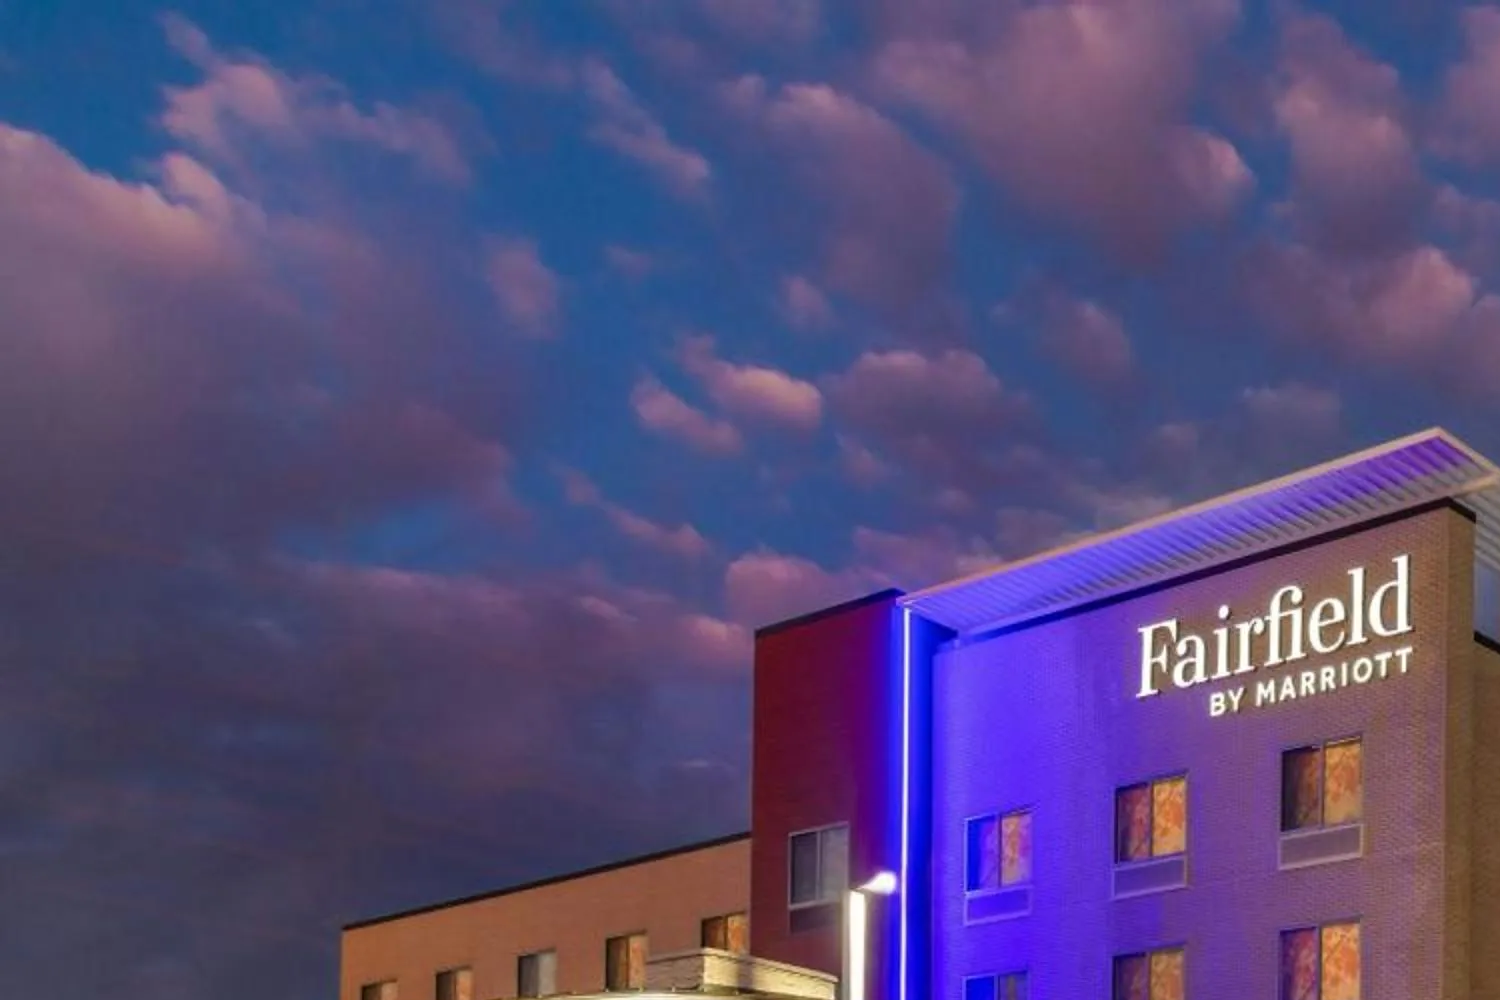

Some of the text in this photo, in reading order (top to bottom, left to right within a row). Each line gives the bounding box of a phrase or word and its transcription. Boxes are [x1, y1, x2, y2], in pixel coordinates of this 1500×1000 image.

[1136, 554, 1413, 698] Fairfield
[1209, 647, 1414, 717] BY MARRIOTT
